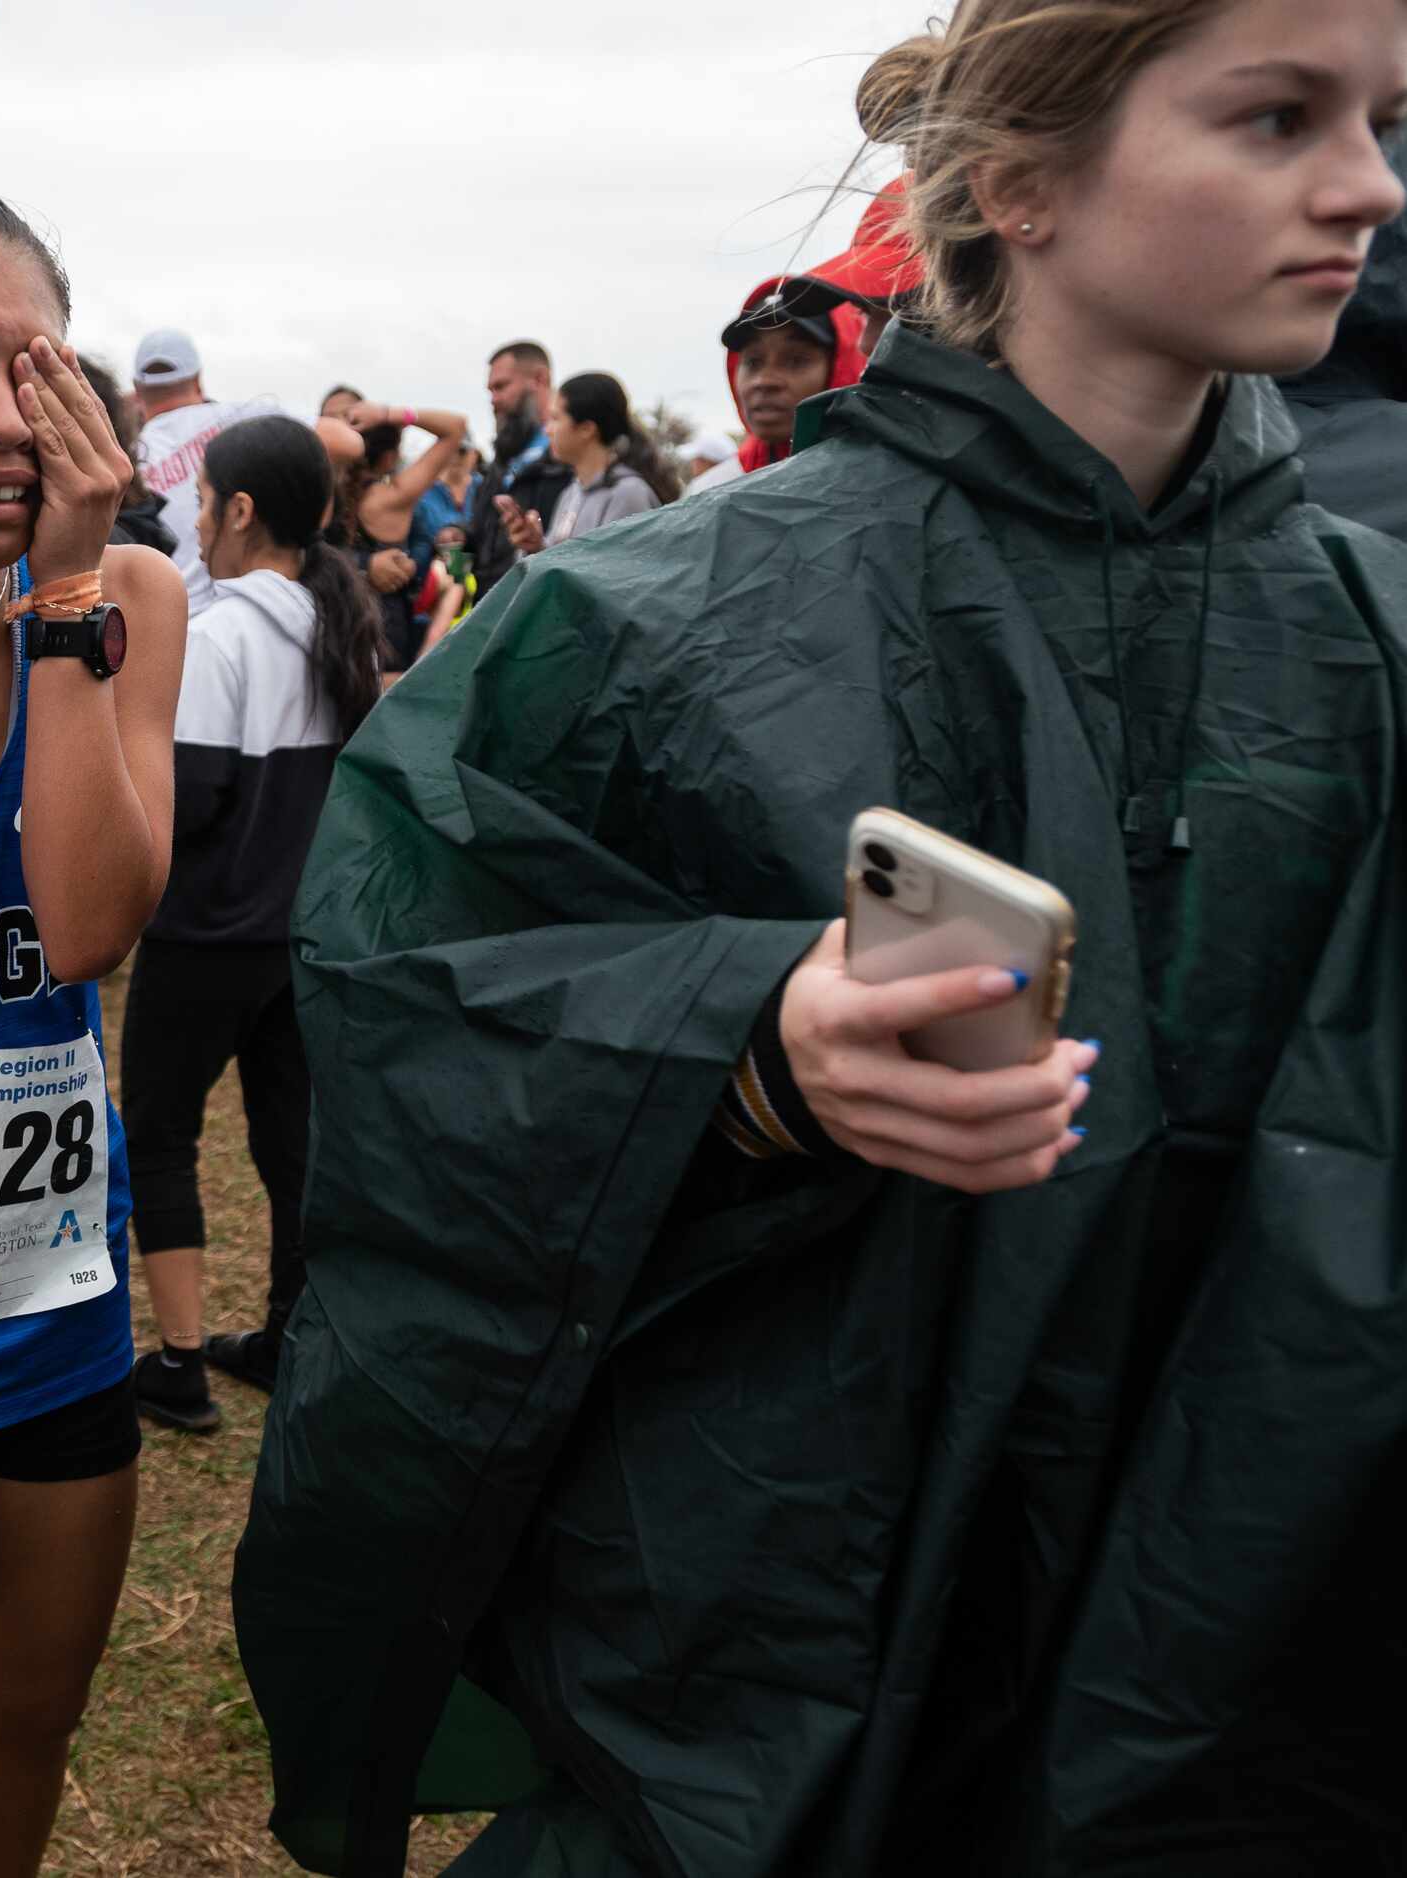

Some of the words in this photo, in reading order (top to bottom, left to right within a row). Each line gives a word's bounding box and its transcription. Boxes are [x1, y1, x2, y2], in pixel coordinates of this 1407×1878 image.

[65, 1049, 76, 1067] II
[24, 1221, 47, 1233] Texas
[69, 1270, 99, 1286] 1928
